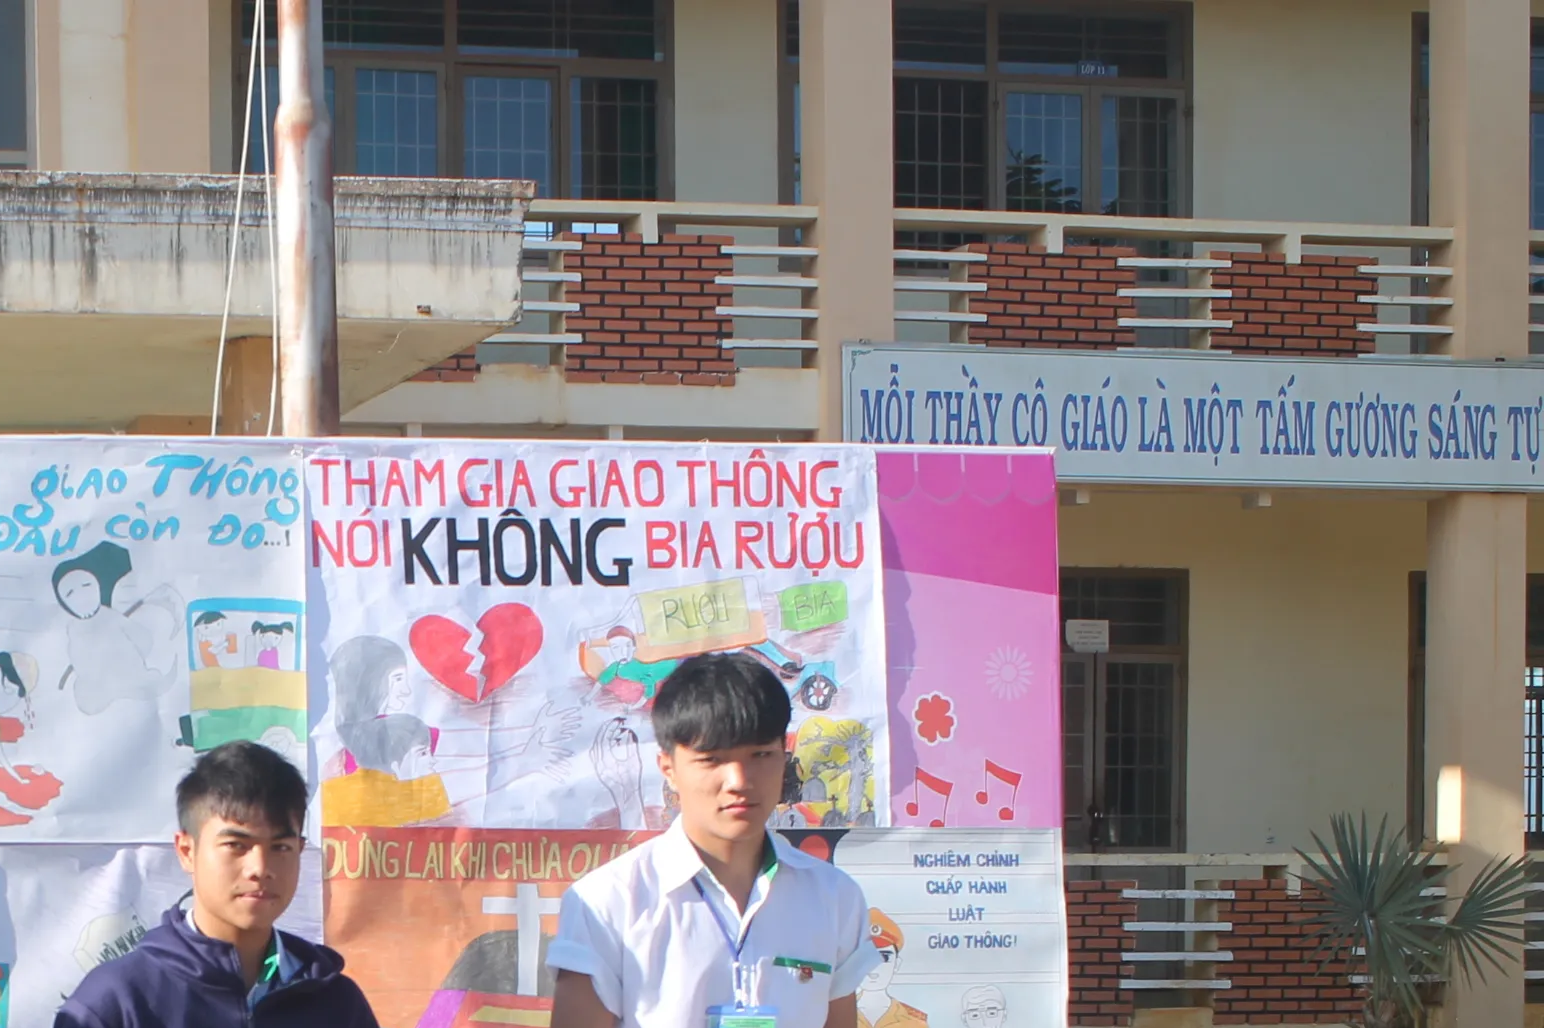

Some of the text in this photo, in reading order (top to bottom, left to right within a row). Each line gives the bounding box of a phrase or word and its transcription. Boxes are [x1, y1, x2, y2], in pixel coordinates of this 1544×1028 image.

[924, 364, 1003, 446] THẦY
[1011, 377, 1048, 447] CÔ
[1060, 376, 1128, 453] GIÁO
[1138, 377, 1174, 453] LÀ
[1183, 382, 1244, 467] MỘT
[1256, 374, 1316, 456] TẤM
[1325, 391, 1418, 459] GƯƠNG
[1428, 389, 1497, 461] SÁNG
[1507, 396, 1543, 475] TỰ
[310, 449, 842, 508] THAM GIA GIAO THÔNG
[311, 508, 864, 586] NÓI KHÔNG BIA RƯỢU
[794, 590, 837, 620] BIA
[405, 840, 444, 883] LẠI
[451, 841, 486, 879] KHI
[492, 836, 564, 880] CHƯA
[913, 849, 971, 868] NGHIÊM
[926, 874, 1007, 894] CHẤP HÀNH
[948, 904, 985, 924] LUẬT
[928, 933, 960, 949] GIAO
